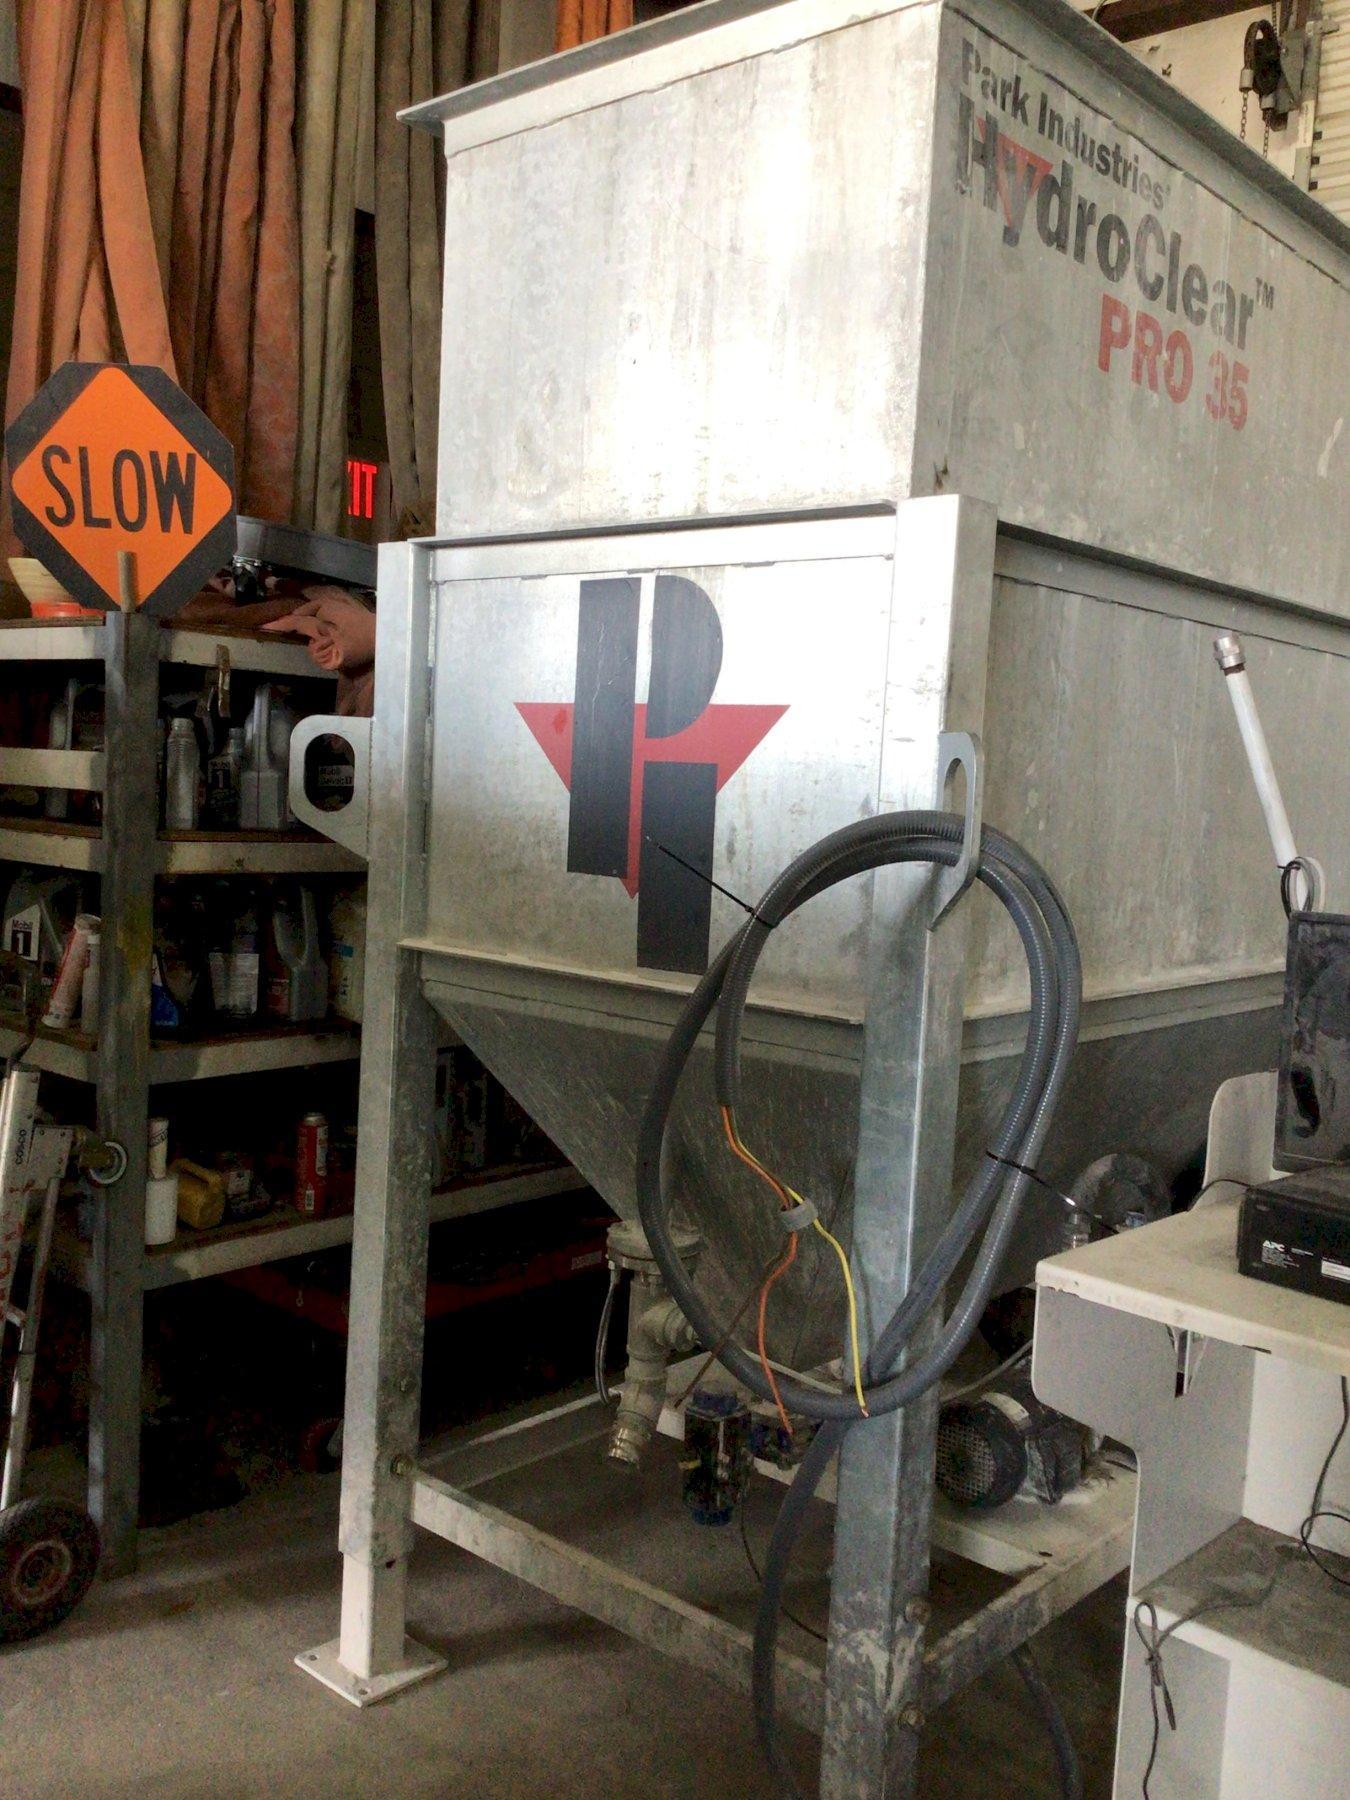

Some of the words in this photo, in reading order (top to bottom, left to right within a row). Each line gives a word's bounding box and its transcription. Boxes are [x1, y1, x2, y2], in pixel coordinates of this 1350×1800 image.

[960, 37, 1030, 126] Park
[1098, 292, 1194, 404] PRO
[1205, 350, 1250, 432] 35
[41, 443, 197, 535] SLOW
[16, 931, 25, 956] 1
[1262, 1239, 1286, 1252] APC
